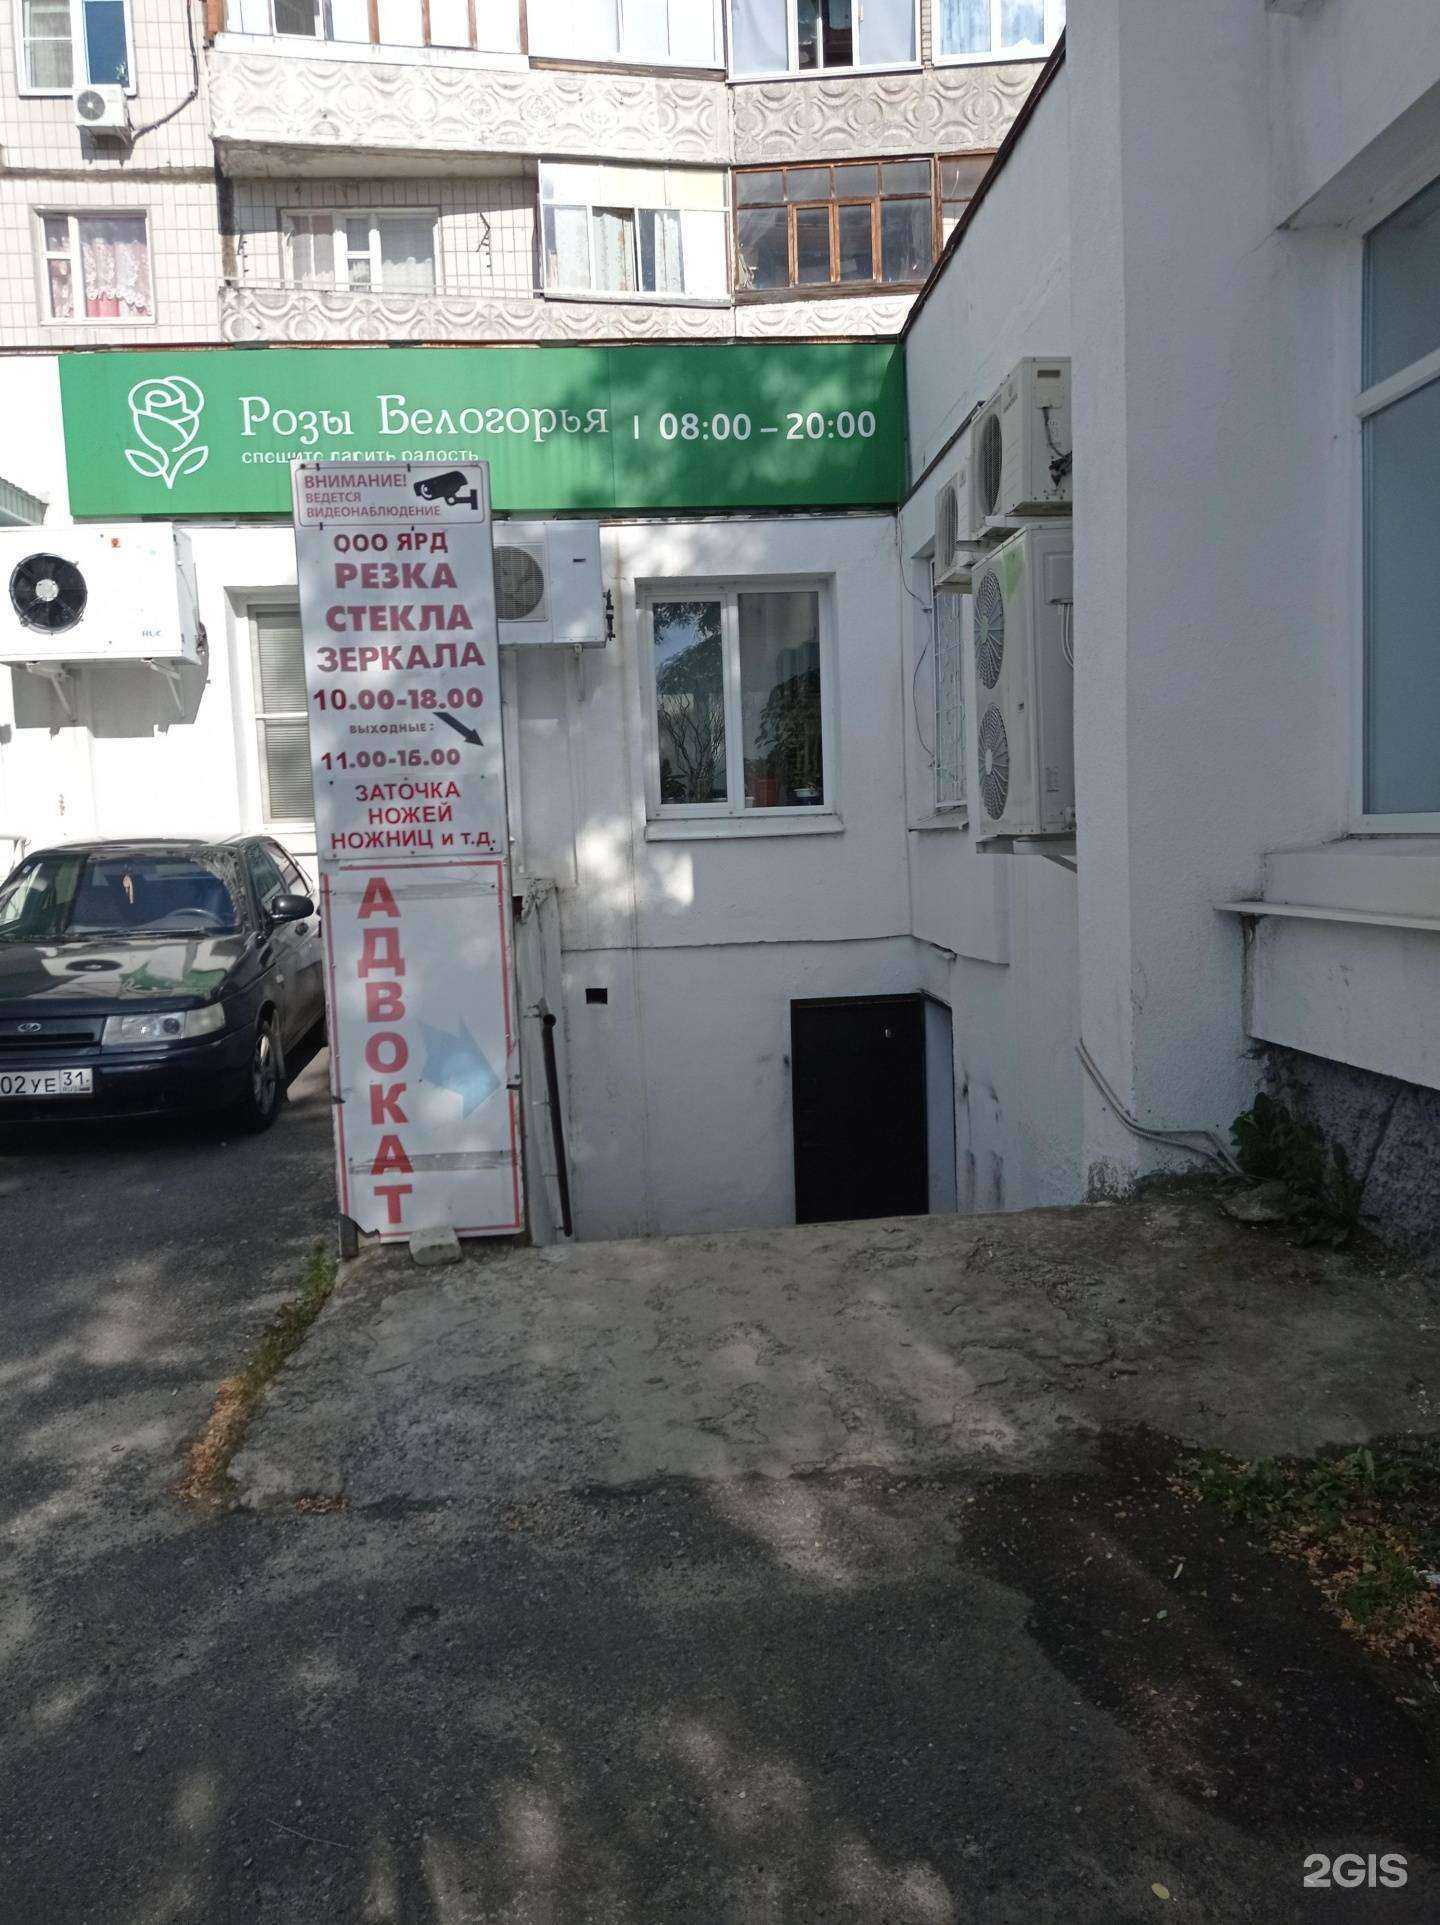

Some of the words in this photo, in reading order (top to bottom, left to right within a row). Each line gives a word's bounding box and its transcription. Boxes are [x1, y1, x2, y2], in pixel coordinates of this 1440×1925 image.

[238, 396, 354, 445] Розы
[376, 394, 610, 442] Белогорья
[658, 412, 751, 441] 08:00
[786, 410, 876, 439] 20:00
[304, 473, 407, 489] ВНИМАНИЕ!
[305, 491, 362, 504] ВЕДЕТСЯ
[307, 505, 441, 519] ВИДЕОНАБЛЮДЕНИЕ
[333, 533, 388, 552] ООО
[396, 531, 448, 554] ЯРД
[334, 561, 458, 589] РЕЗКА
[325, 604, 474, 632] СТЕКЛА
[317, 642, 486, 673] ЗЕРКАЛА
[313, 687, 484, 711] 10.00-18.00
[355, 781, 461, 802] ЗАТОЧКА
[368, 802, 453, 825] НОЖЕЙ
[331, 829, 434, 850] НОЖНИЦ
[357, 876, 414, 1224] АДВОКАТ
[63, 1071, 84, 1087] 31
